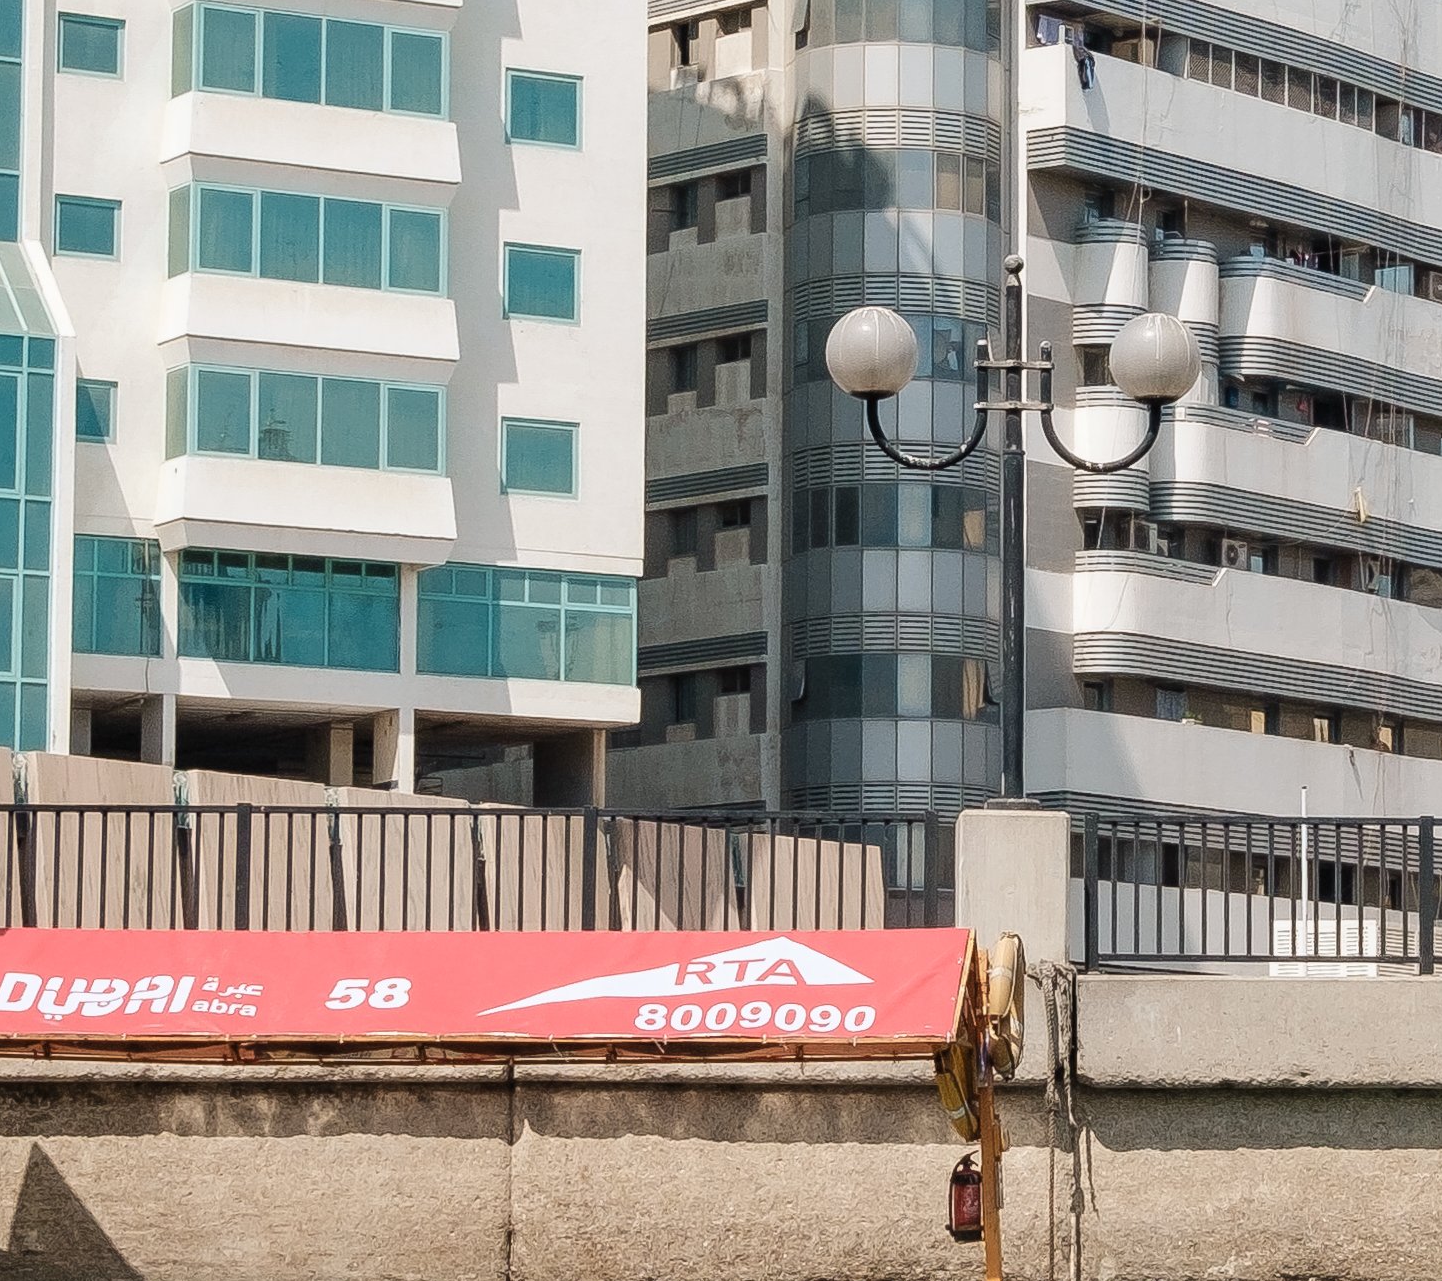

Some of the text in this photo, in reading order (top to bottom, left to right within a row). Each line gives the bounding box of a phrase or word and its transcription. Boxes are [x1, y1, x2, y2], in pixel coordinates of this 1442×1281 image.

[674, 958, 807, 985] RTA
[201, 976, 264, 998] عبرة
[324, 976, 412, 1010] 58
[191, 998, 258, 1018] abra
[634, 1001, 877, 1032] 8009090
